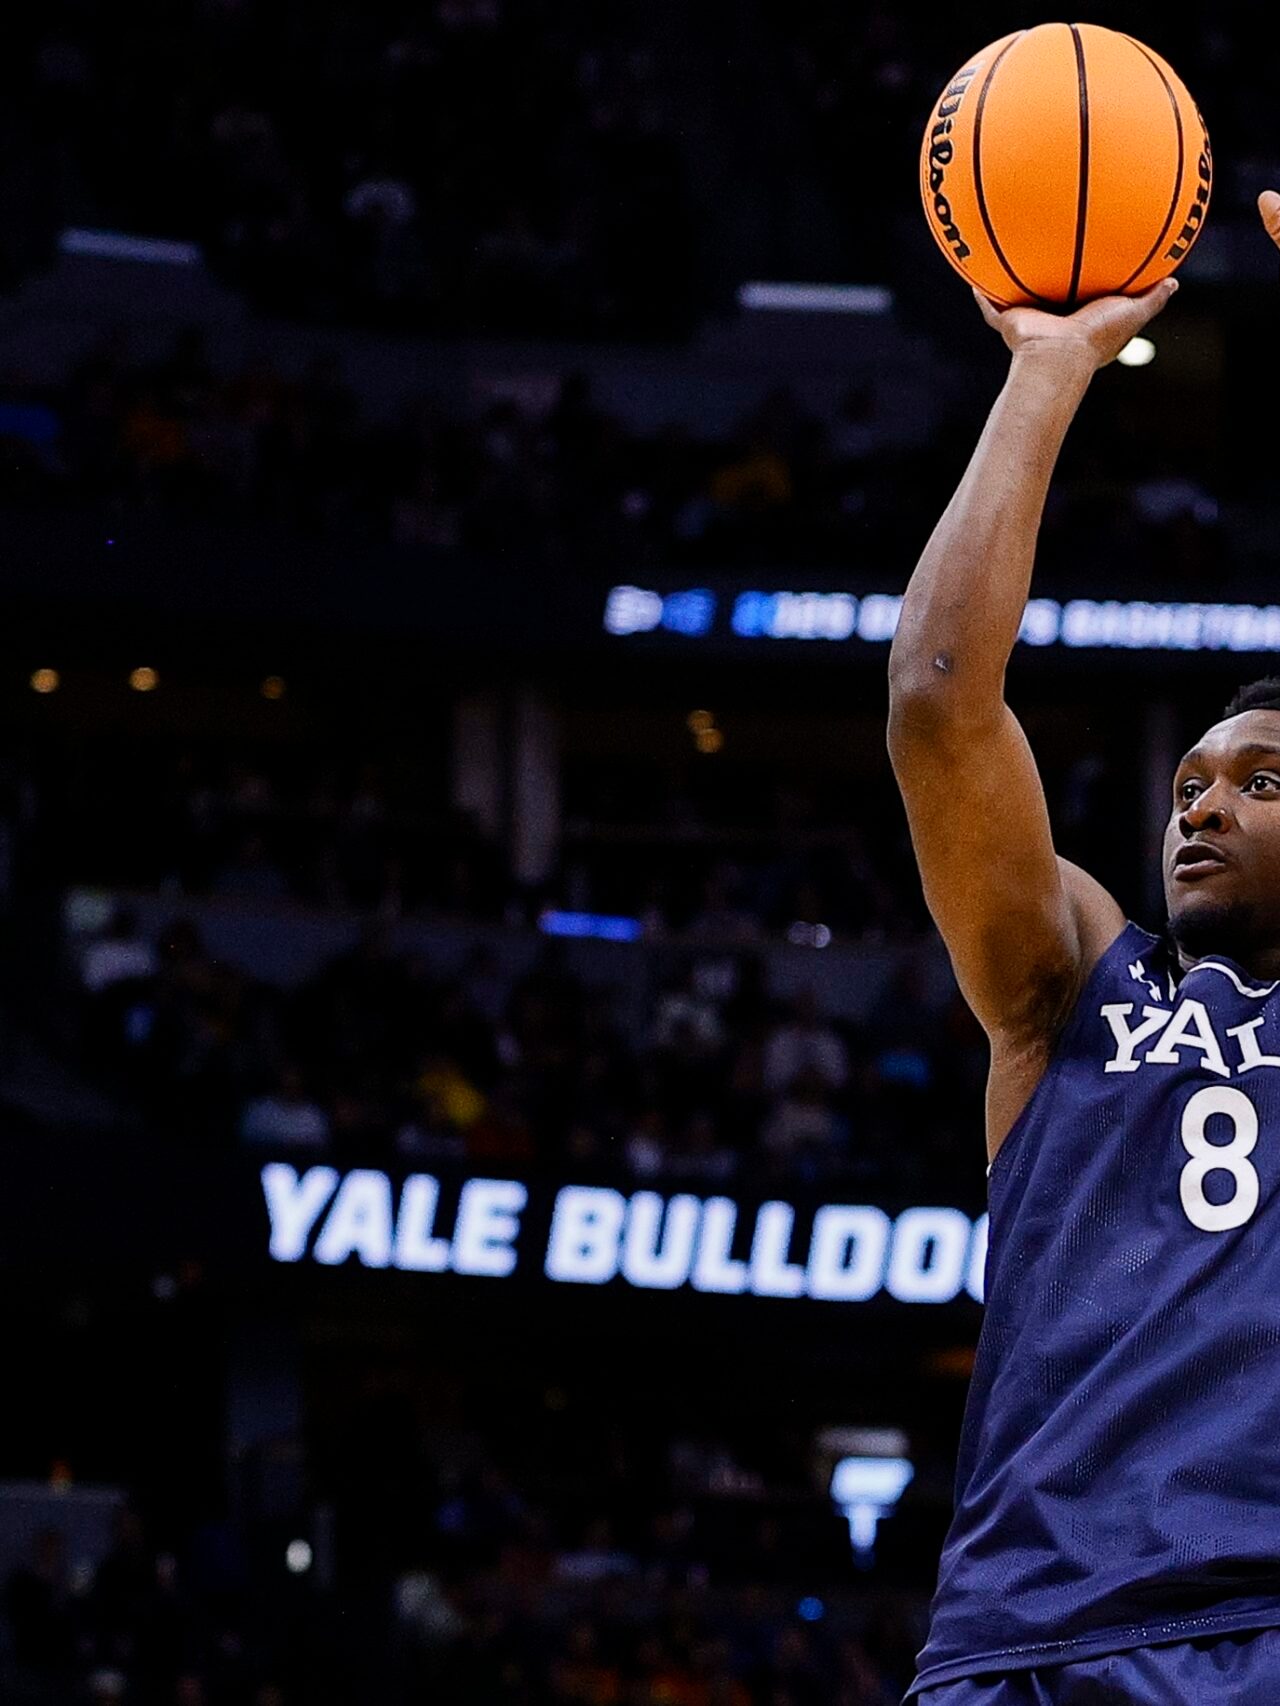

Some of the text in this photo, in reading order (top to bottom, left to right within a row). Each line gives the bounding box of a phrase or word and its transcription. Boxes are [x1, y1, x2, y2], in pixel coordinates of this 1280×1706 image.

[929, 66, 976, 261] Wilson
[1179, 1085, 1260, 1233] 8
[262, 1163, 987, 1304] YALE BULLDO
